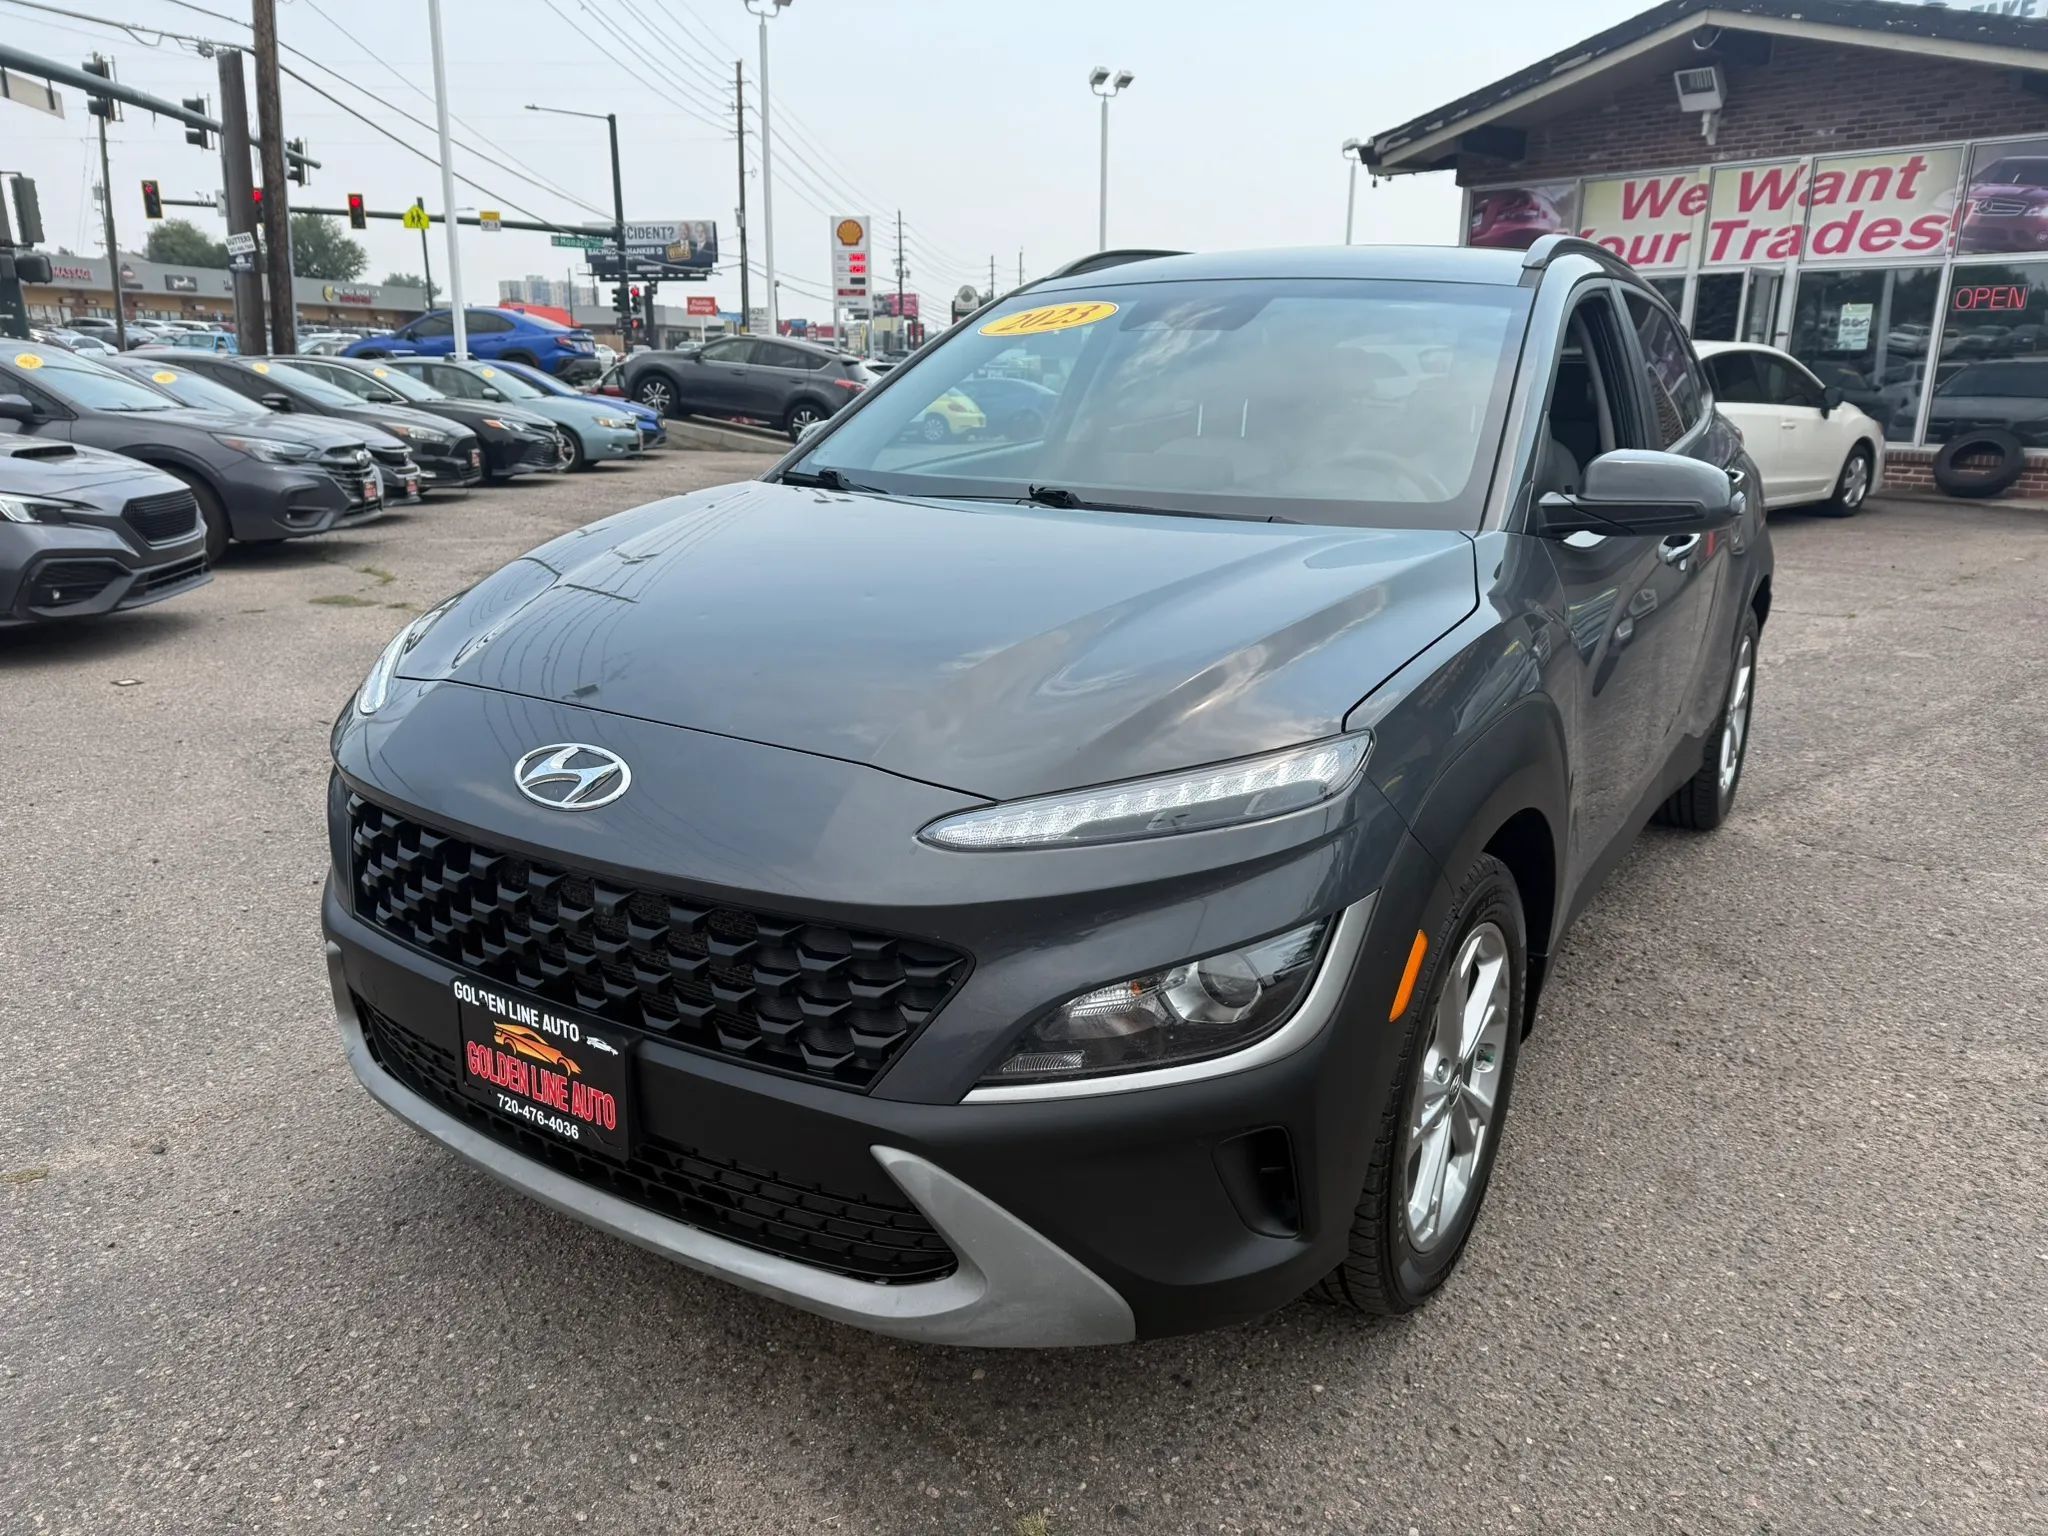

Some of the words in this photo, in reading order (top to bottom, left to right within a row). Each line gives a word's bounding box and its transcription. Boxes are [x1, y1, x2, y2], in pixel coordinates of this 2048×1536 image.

[1621, 176, 1708, 220] We
[1738, 155, 1927, 213] Want
[559, 237, 590, 247] Monaco
[623, 226, 675, 240] CIDENT?
[1709, 201, 1973, 262] Trades!
[994, 304, 1102, 332] 2023
[1955, 286, 2028, 310] OPEN
[453, 980, 506, 1016] GOLDEN
[508, 1001, 539, 1028] LINE
[542, 1013, 580, 1042] AUTO
[466, 1040, 529, 1097] GOLDEN
[530, 1065, 569, 1112] LINE
[571, 1080, 617, 1131] AUTO
[497, 1093, 580, 1140] 720-476-4036
